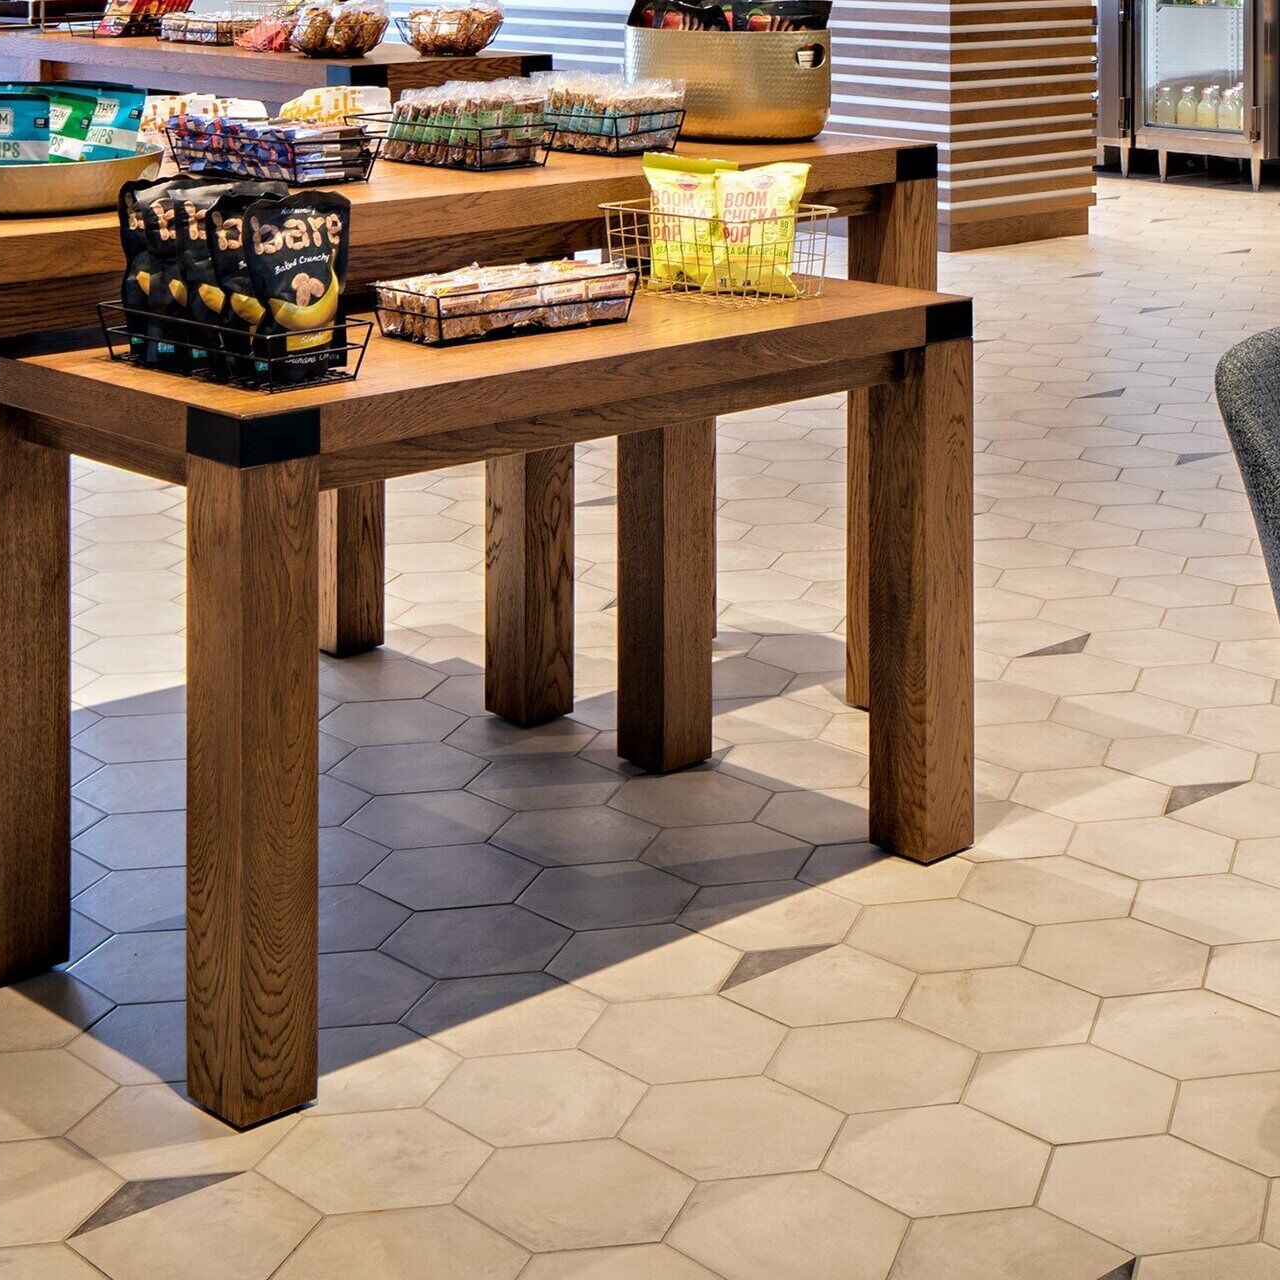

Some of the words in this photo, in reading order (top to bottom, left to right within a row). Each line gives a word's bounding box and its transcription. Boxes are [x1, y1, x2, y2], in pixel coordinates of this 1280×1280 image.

[652, 189, 694, 208] BOOM
[724, 191, 768, 208] BOOM
[724, 208, 779, 225] CHICKA
[250, 213, 342, 255] bare
[653, 224, 681, 242] POP
[723, 225, 750, 243] POP
[274, 259, 297, 275] Baked
[299, 253, 330, 264] Crunchy
